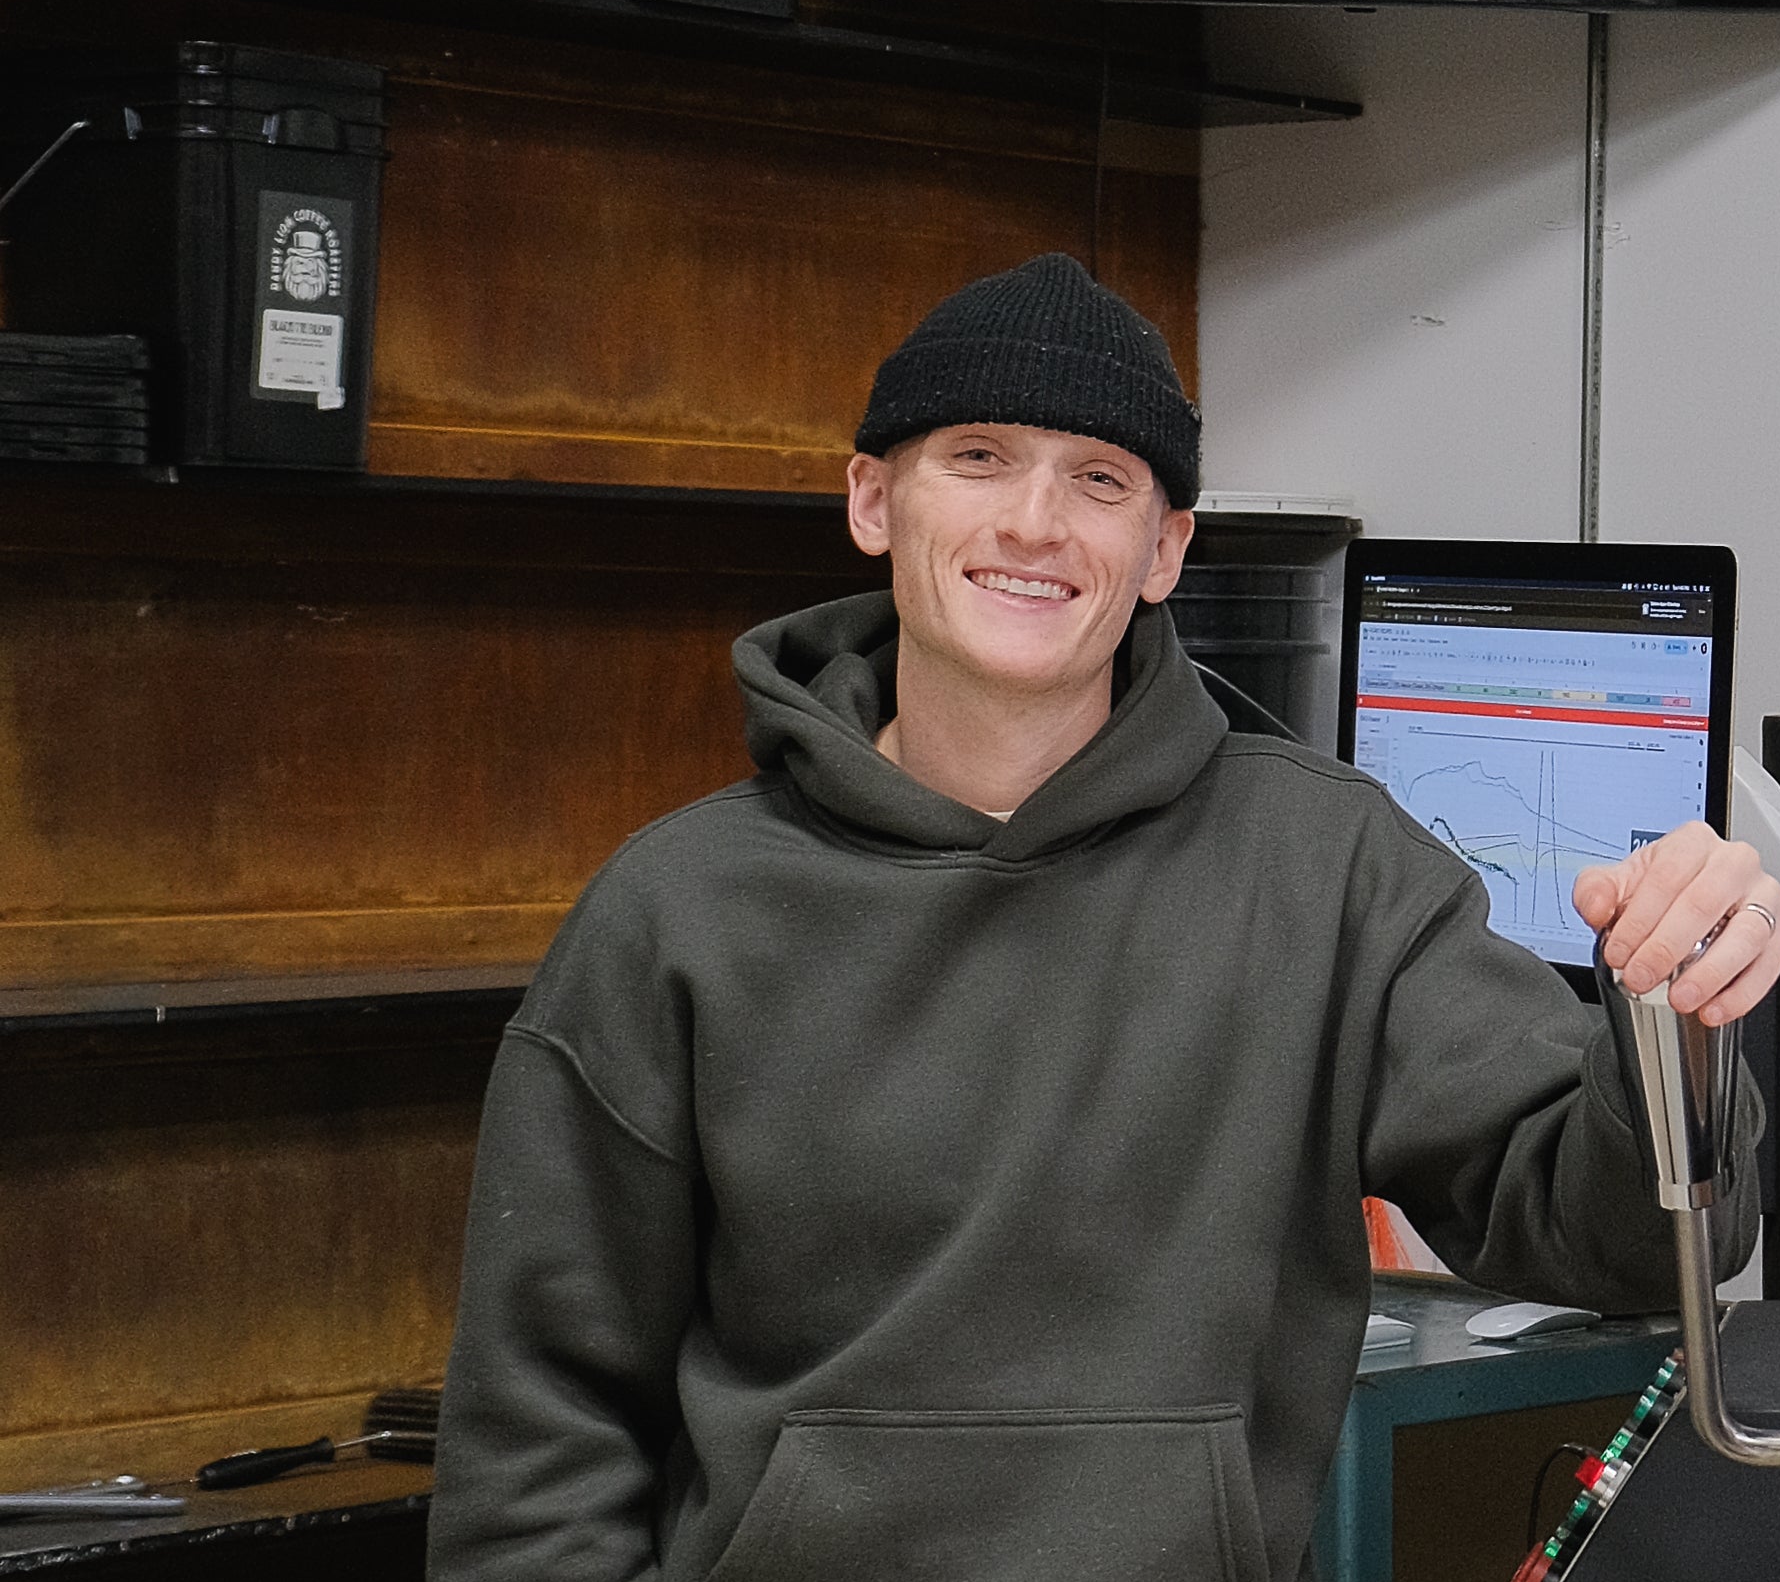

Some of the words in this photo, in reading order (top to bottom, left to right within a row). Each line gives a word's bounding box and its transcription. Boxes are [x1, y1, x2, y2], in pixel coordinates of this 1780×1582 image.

[273, 215, 296, 244] LION
[293, 209, 331, 231] COFFEE
[270, 247, 284, 291] DANDY
[325, 229, 342, 296] ROASTERS
